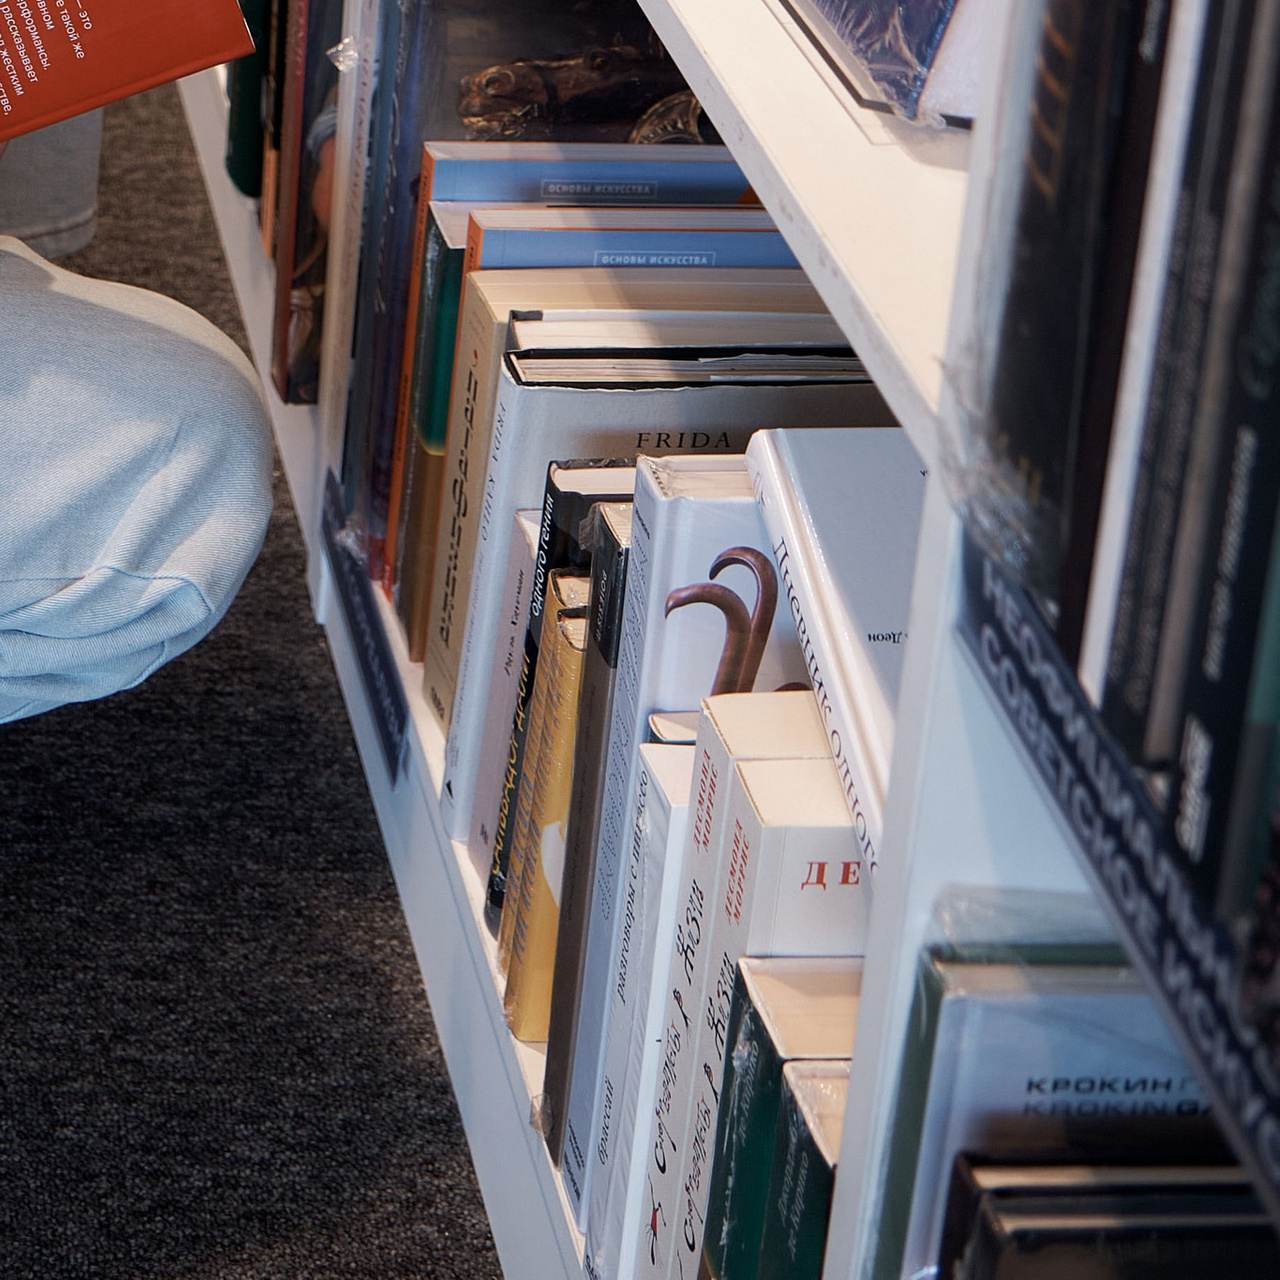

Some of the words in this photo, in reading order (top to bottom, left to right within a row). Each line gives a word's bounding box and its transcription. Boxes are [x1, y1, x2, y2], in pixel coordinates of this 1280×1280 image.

[59, 8, 80, 41] такой
[72, 42, 85, 59] же
[78, 10, 93, 30] это
[0, 48, 24, 96] жестким
[548, 182, 593, 195] ОСНОВЫ
[595, 182, 651, 196] ИСКУССТВА
[601, 254, 647, 266] ОСНОВЫ
[649, 254, 709, 267] ИСКУССТВА
[490, 400, 506, 462] FRIDA
[635, 431, 732, 450] FRIDA
[479, 473, 495, 540] KAHLO
[538, 493, 555, 542] гения
[529, 546, 550, 616] одного
[771, 536, 832, 718] Дневник
[691, 748, 714, 853] ДЕСМОНД
[698, 762, 721, 853] МОРРИС
[721, 818, 745, 923] ДЕСМОНД
[730, 834, 752, 925] МОРРИС
[614, 882, 641, 1003] разговоры
[1026, 1075, 1173, 1095] КРОКИН
[595, 1075, 616, 1164] брассай
